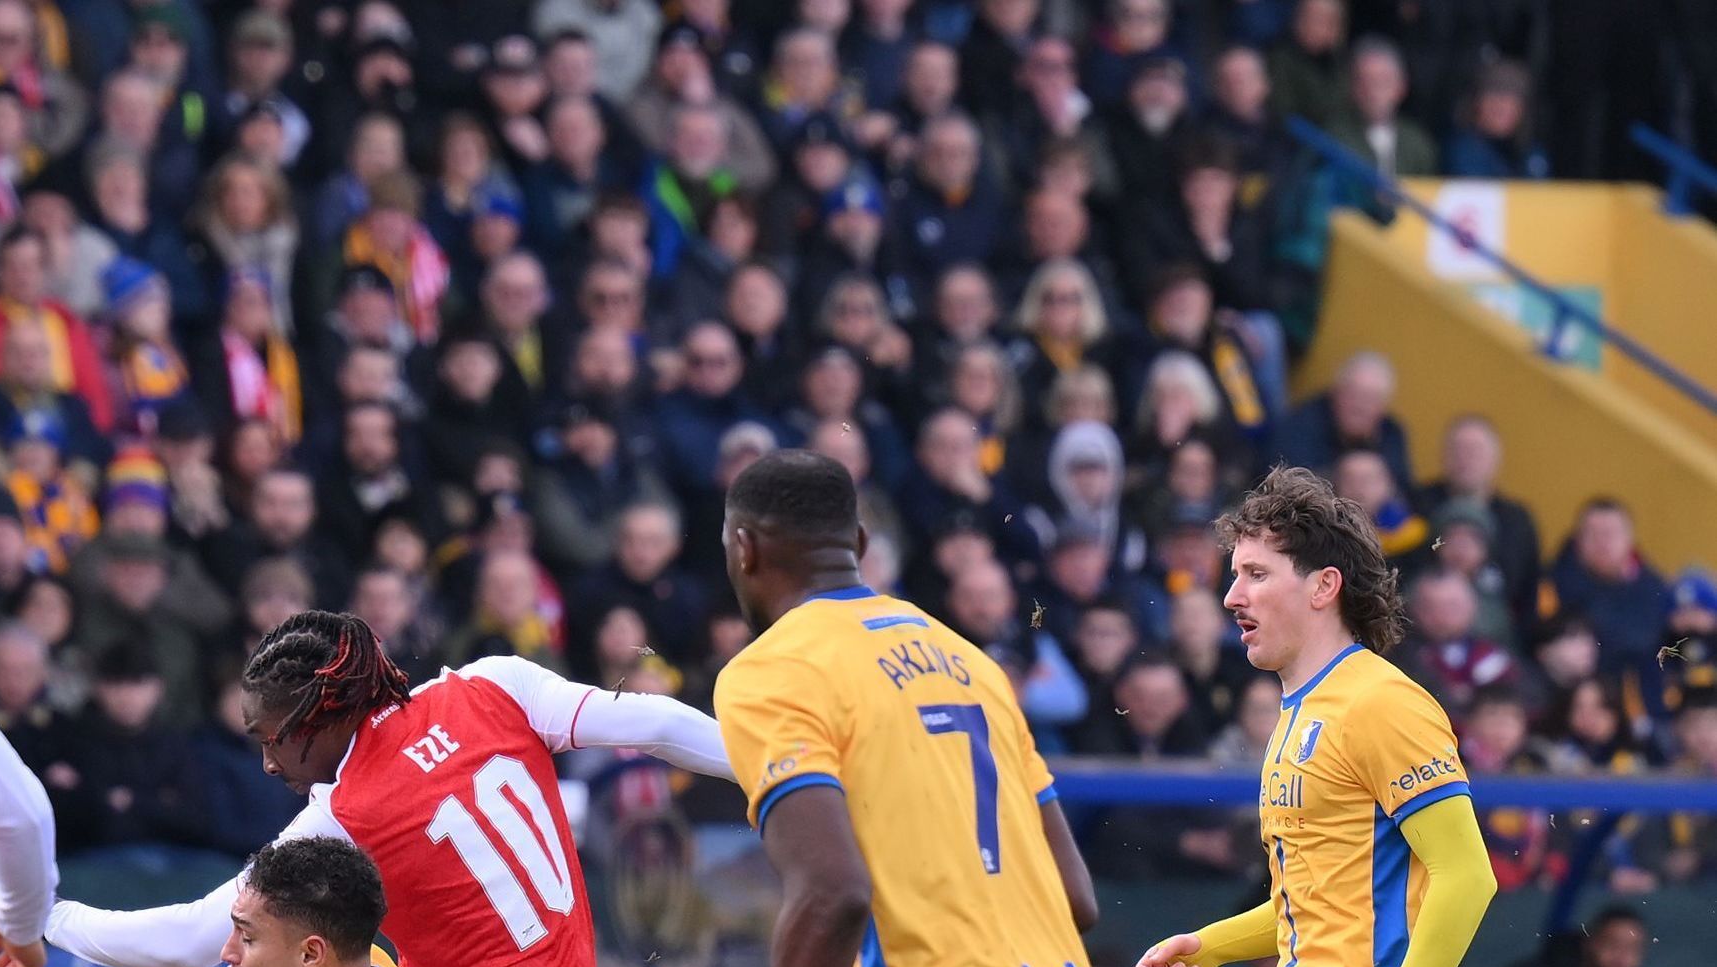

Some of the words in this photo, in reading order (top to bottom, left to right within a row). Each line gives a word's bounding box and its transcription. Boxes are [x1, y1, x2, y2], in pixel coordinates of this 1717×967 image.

[877, 640, 971, 691] AKINS
[402, 723, 461, 774] EZE
[917, 704, 1001, 875] 7
[1269, 771, 1303, 809] Call
[424, 754, 576, 953] 10
